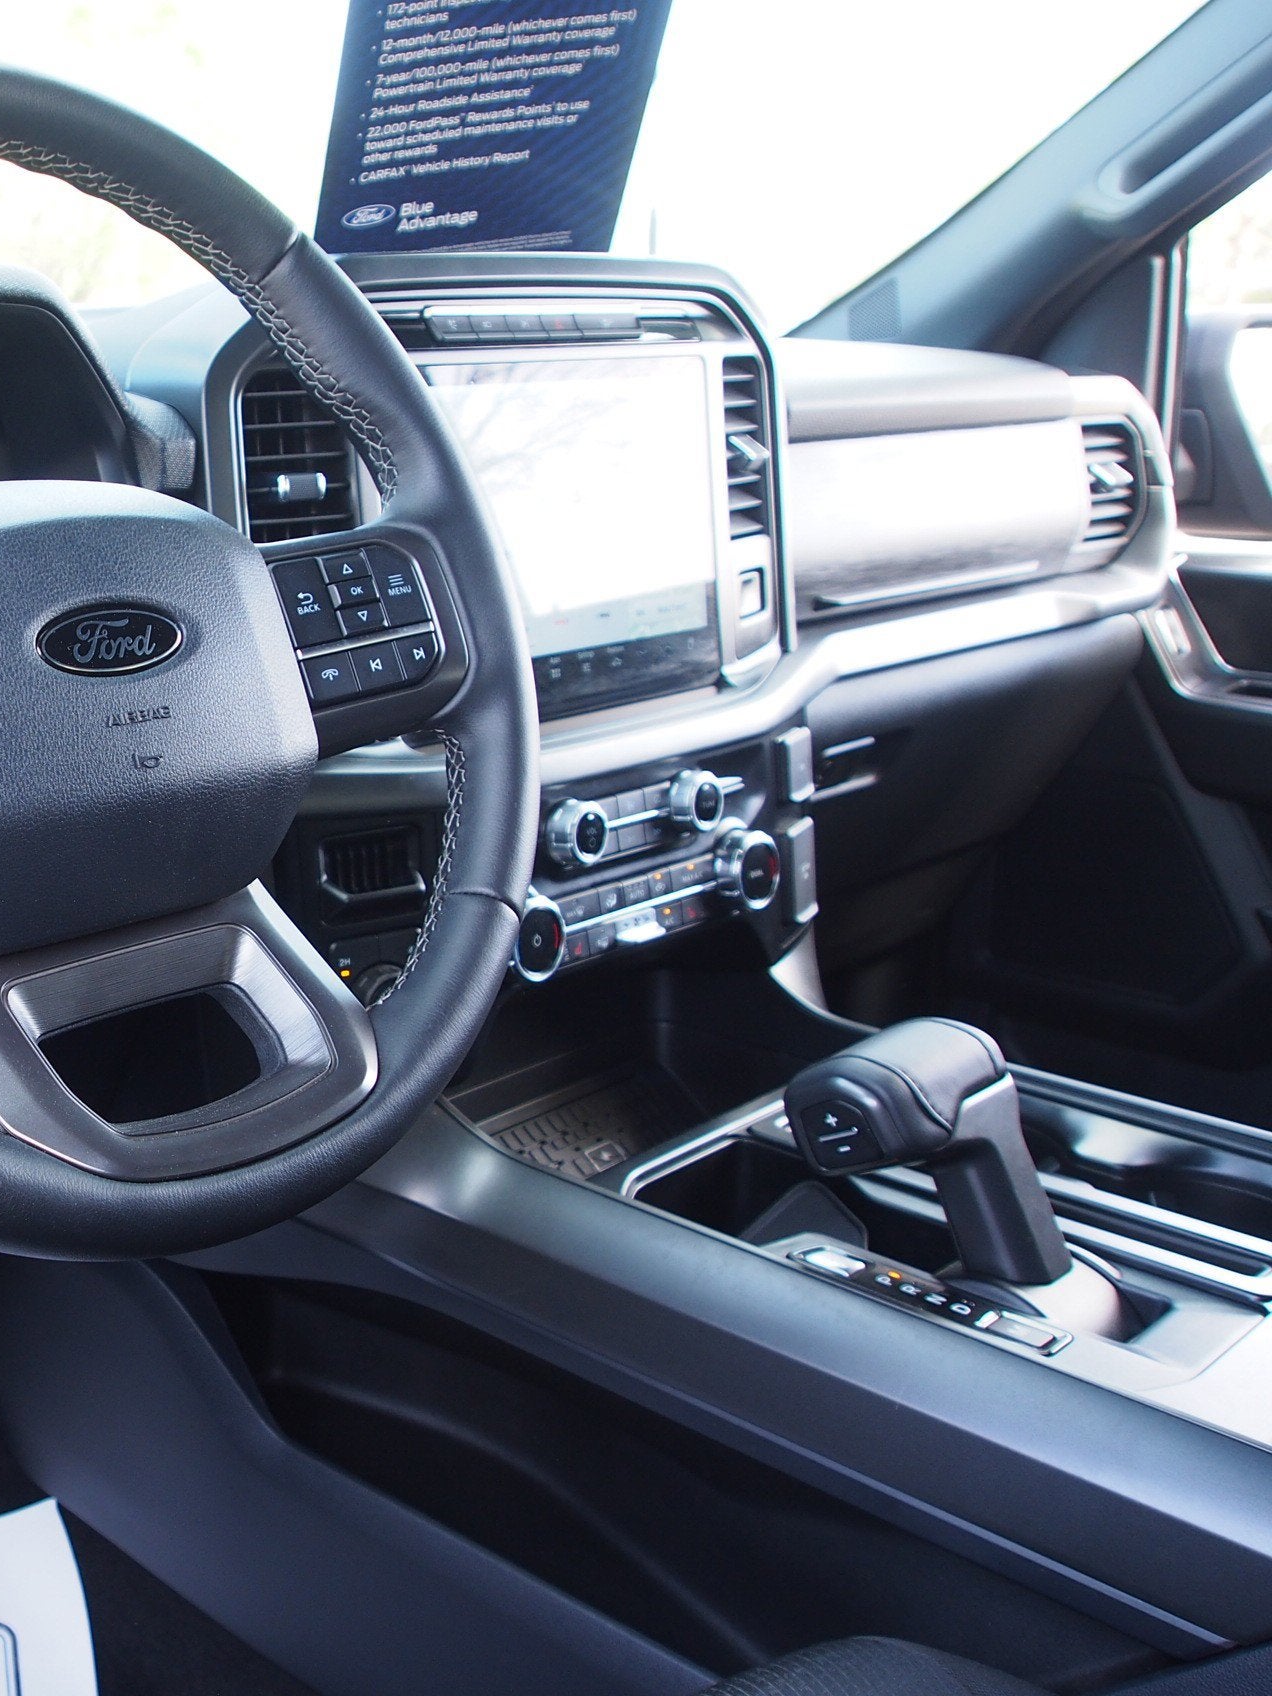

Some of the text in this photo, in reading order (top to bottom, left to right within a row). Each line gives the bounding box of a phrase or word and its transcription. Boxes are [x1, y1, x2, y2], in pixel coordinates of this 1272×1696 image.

[385, 11, 449, 30] technicians
[507, 17, 569, 34] (whichever
[570, 12, 608, 24] comes
[609, 8, 638, 21] first)
[379, 42, 466, 65] Comprehensive
[468, 36, 510, 51] Limited
[512, 30, 564, 45] Warranty
[491, 52, 552, 69] (whichever
[553, 48, 591, 60] comes
[592, 43, 620, 56] first)
[373, 80, 433, 99] Powertrain
[435, 72, 478, 88] Limited
[480, 67, 531, 82] Warranty
[369, 103, 416, 119] 24-Hour
[417, 94, 469, 110] Roadside
[467, 106, 515, 122] Rewards
[556, 101, 569, 112] to
[570, 99, 590, 110] use
[365, 113, 579, 151] toward scheduled maintenance visits or
[363, 143, 438, 164] other rewards
[411, 158, 450, 174] Vehicle
[452, 154, 491, 168] History
[492, 148, 530, 163] Report
[397, 209, 479, 233] Advantage
[400, 201, 435, 217] Blue
[350, 585, 364, 596] OK
[387, 585, 412, 597] MENU
[296, 603, 321, 616] BACK
[73, 618, 157, 664] Ford
[338, 957, 351, 968] 2H
[875, 1273, 972, 1315] P R N D
